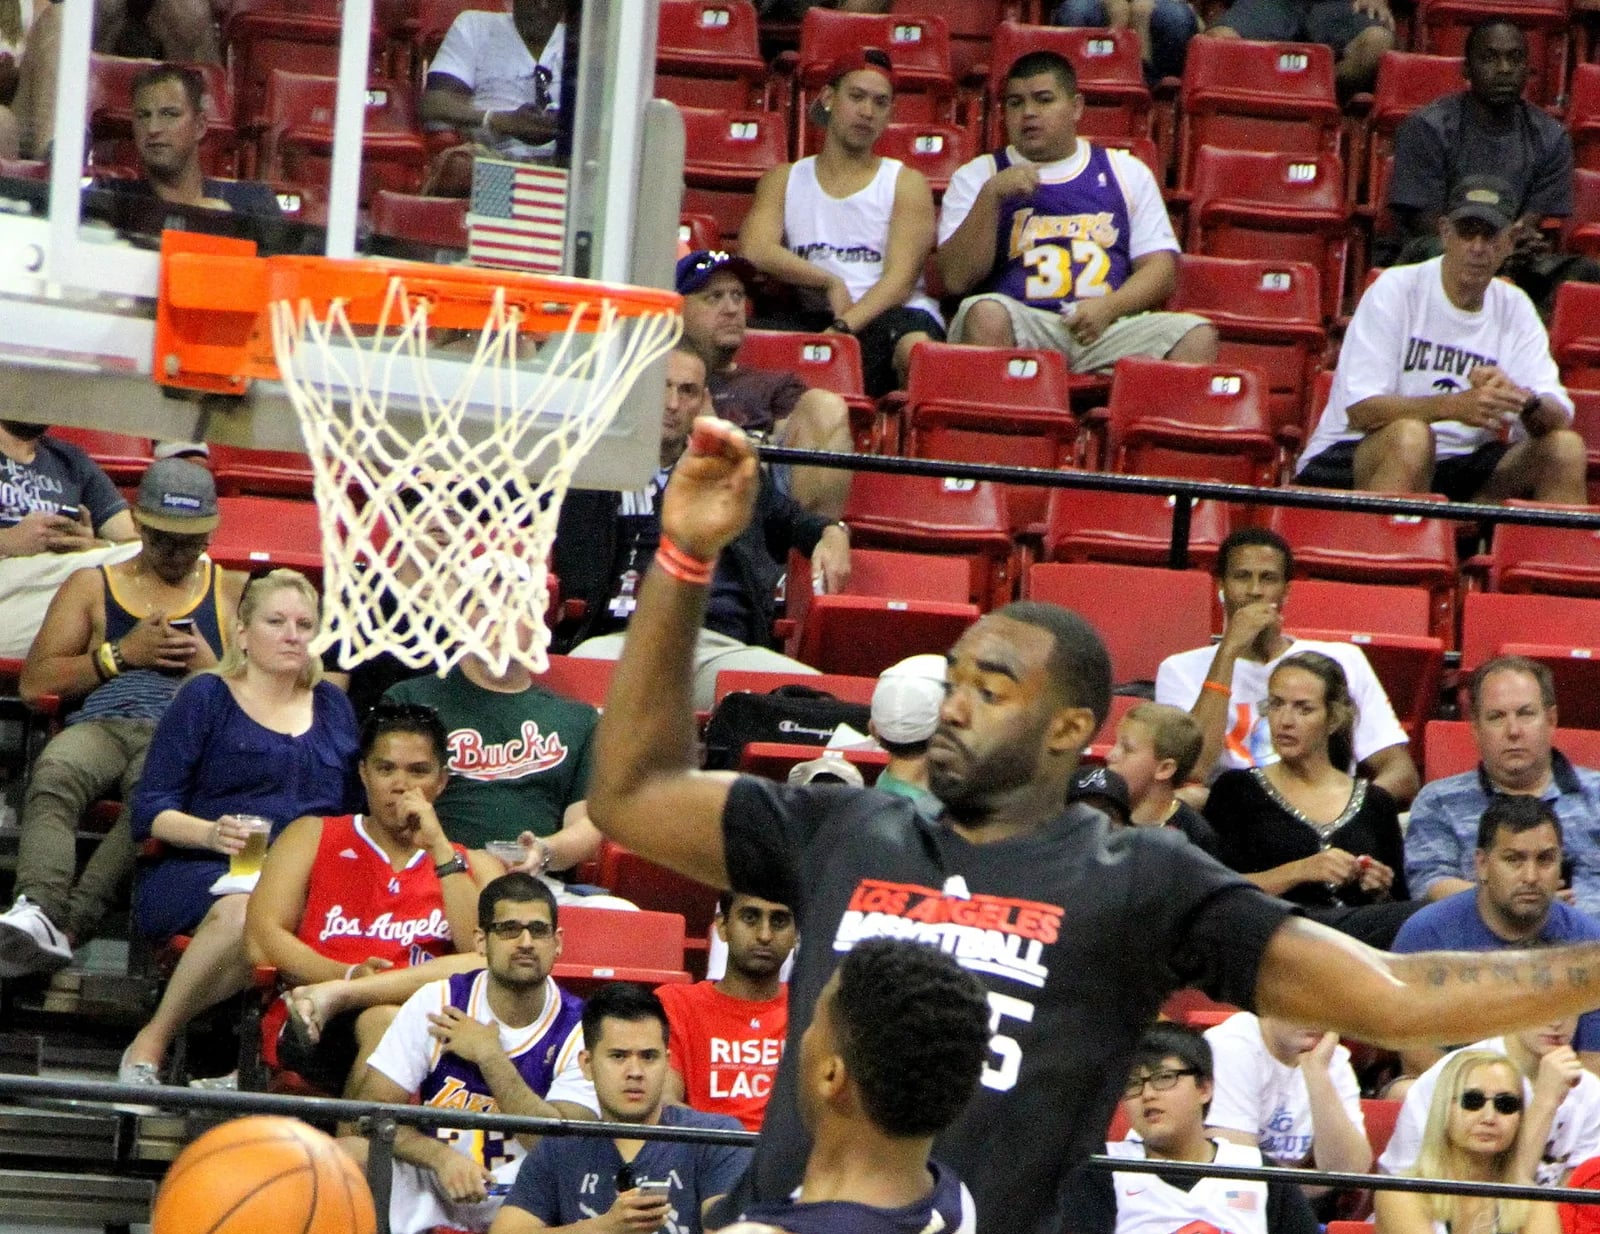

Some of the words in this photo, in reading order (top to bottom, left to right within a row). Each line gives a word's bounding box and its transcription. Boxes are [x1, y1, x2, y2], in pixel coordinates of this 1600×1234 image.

[1023, 239, 1113, 299] 32
[1403, 336, 1432, 372] UC
[447, 720, 568, 777] Bucks
[319, 905, 362, 942] Los
[366, 908, 449, 947] Angele
[710, 1037, 785, 1067] RISE
[709, 1070, 772, 1099] LAC
